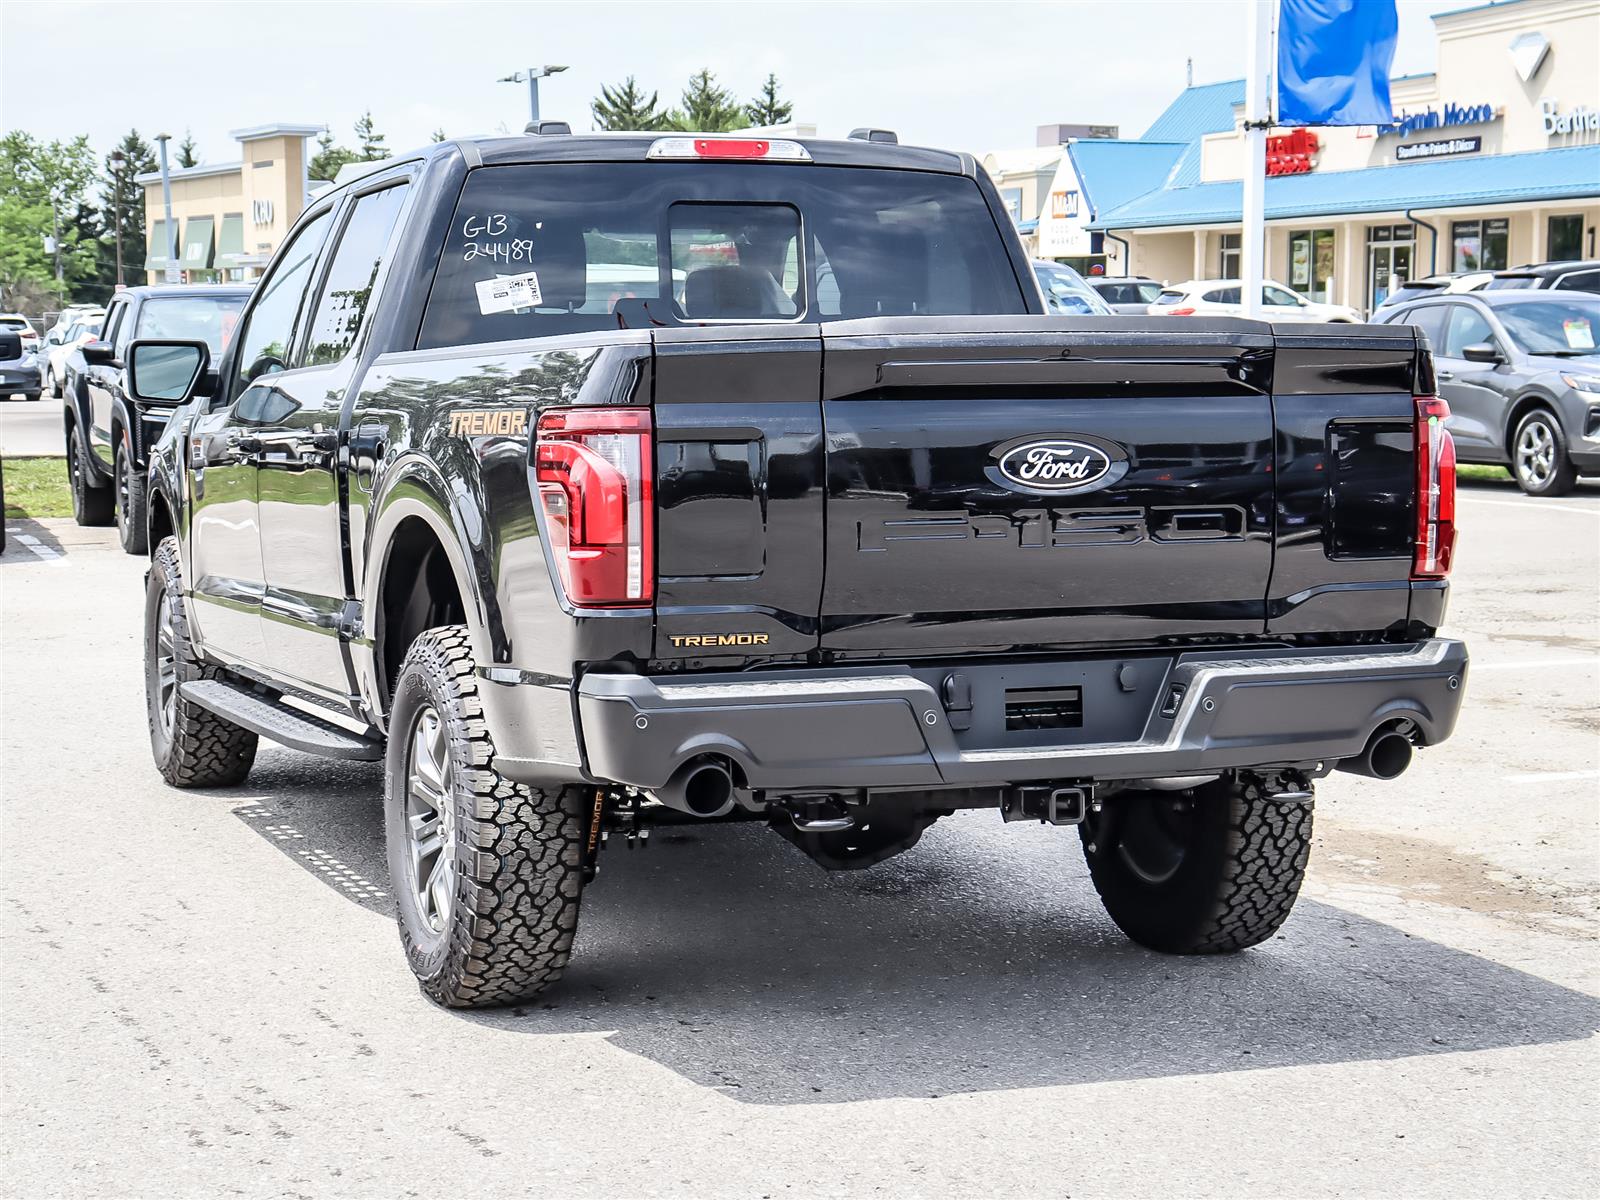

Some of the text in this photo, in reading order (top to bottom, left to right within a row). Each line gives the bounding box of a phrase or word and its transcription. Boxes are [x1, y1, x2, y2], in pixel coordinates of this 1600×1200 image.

[1443, 102, 1493, 127] Moore
[1053, 193, 1077, 215] M&M
[464, 238, 534, 264] 24489
[448, 410, 526, 436] TREMOR
[1019, 447, 1091, 480] Ford
[857, 504, 1247, 552] F-150
[669, 634, 769, 647] TREMOR
[588, 790, 604, 852] TREMOR
